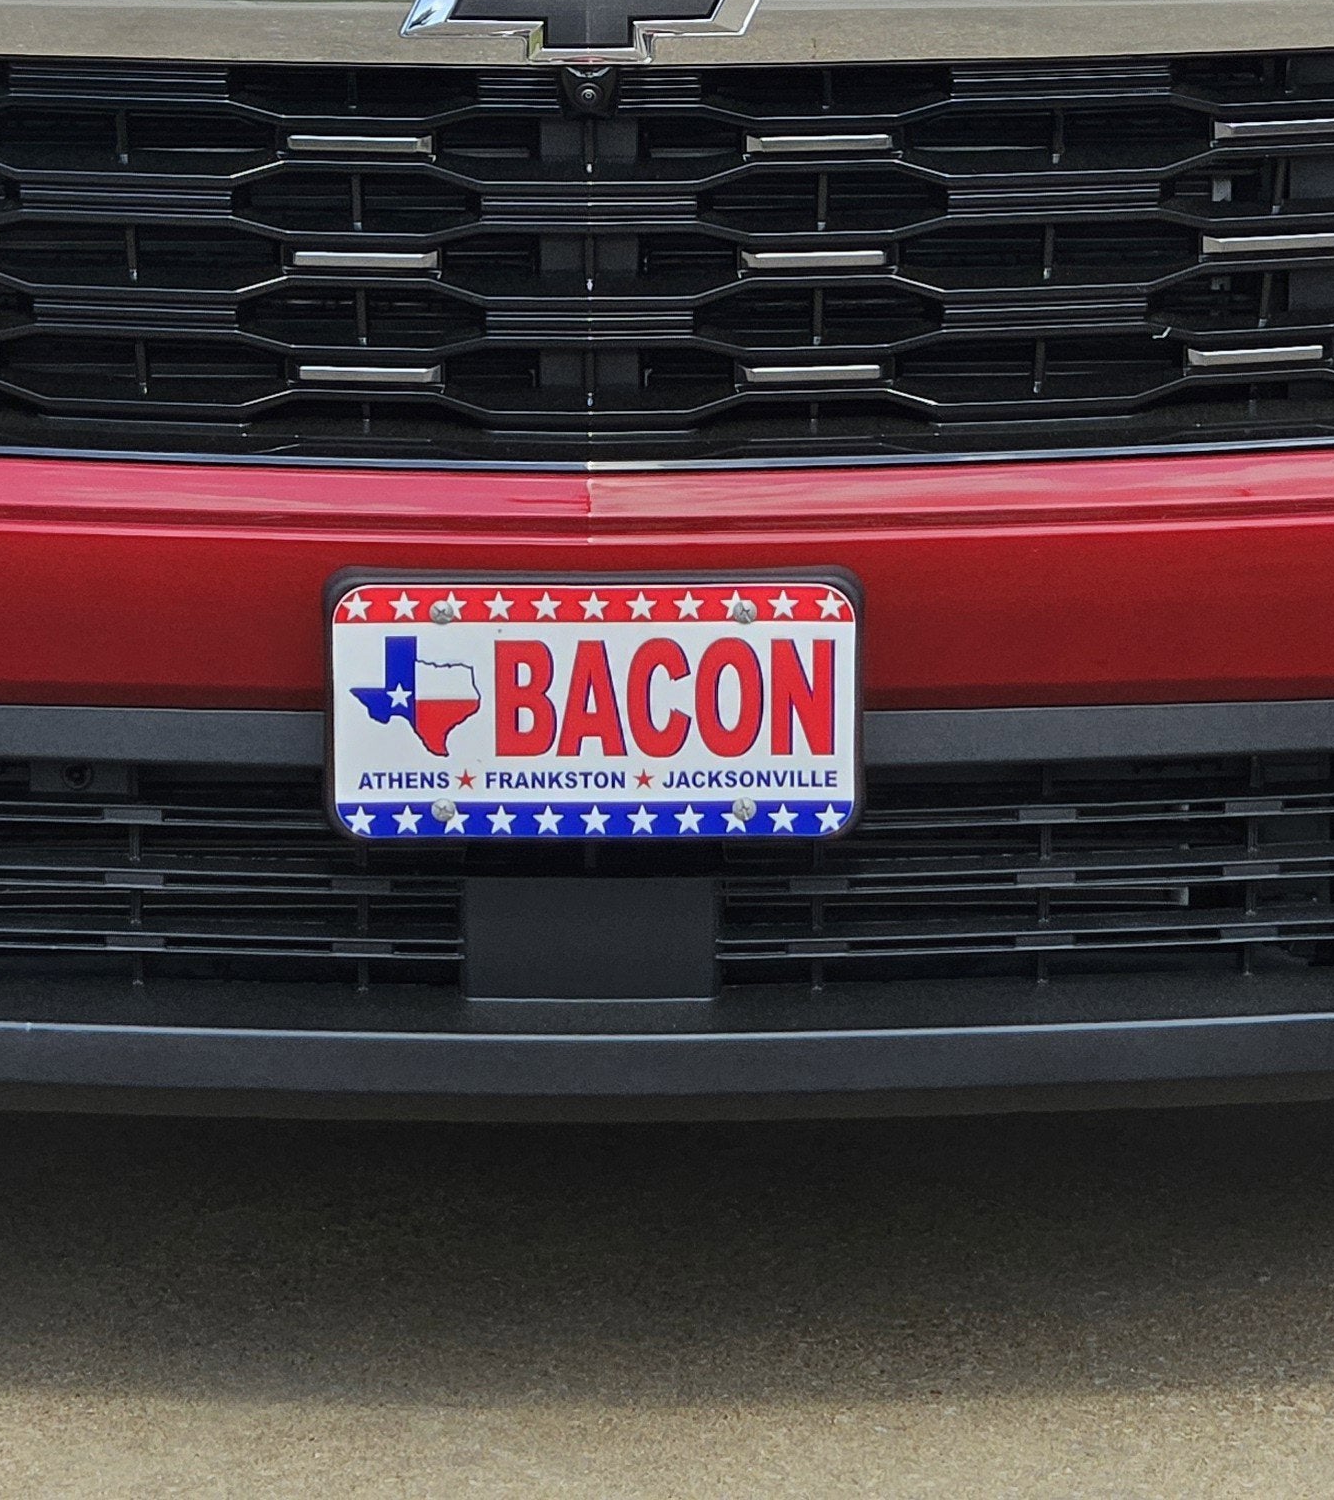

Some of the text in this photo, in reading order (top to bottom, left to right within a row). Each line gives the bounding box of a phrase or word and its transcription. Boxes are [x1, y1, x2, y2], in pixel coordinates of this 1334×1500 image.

[494, 637, 836, 758] BACON
[358, 770, 838, 790] ATHENS FRANKSTON JACKSONVILLE
